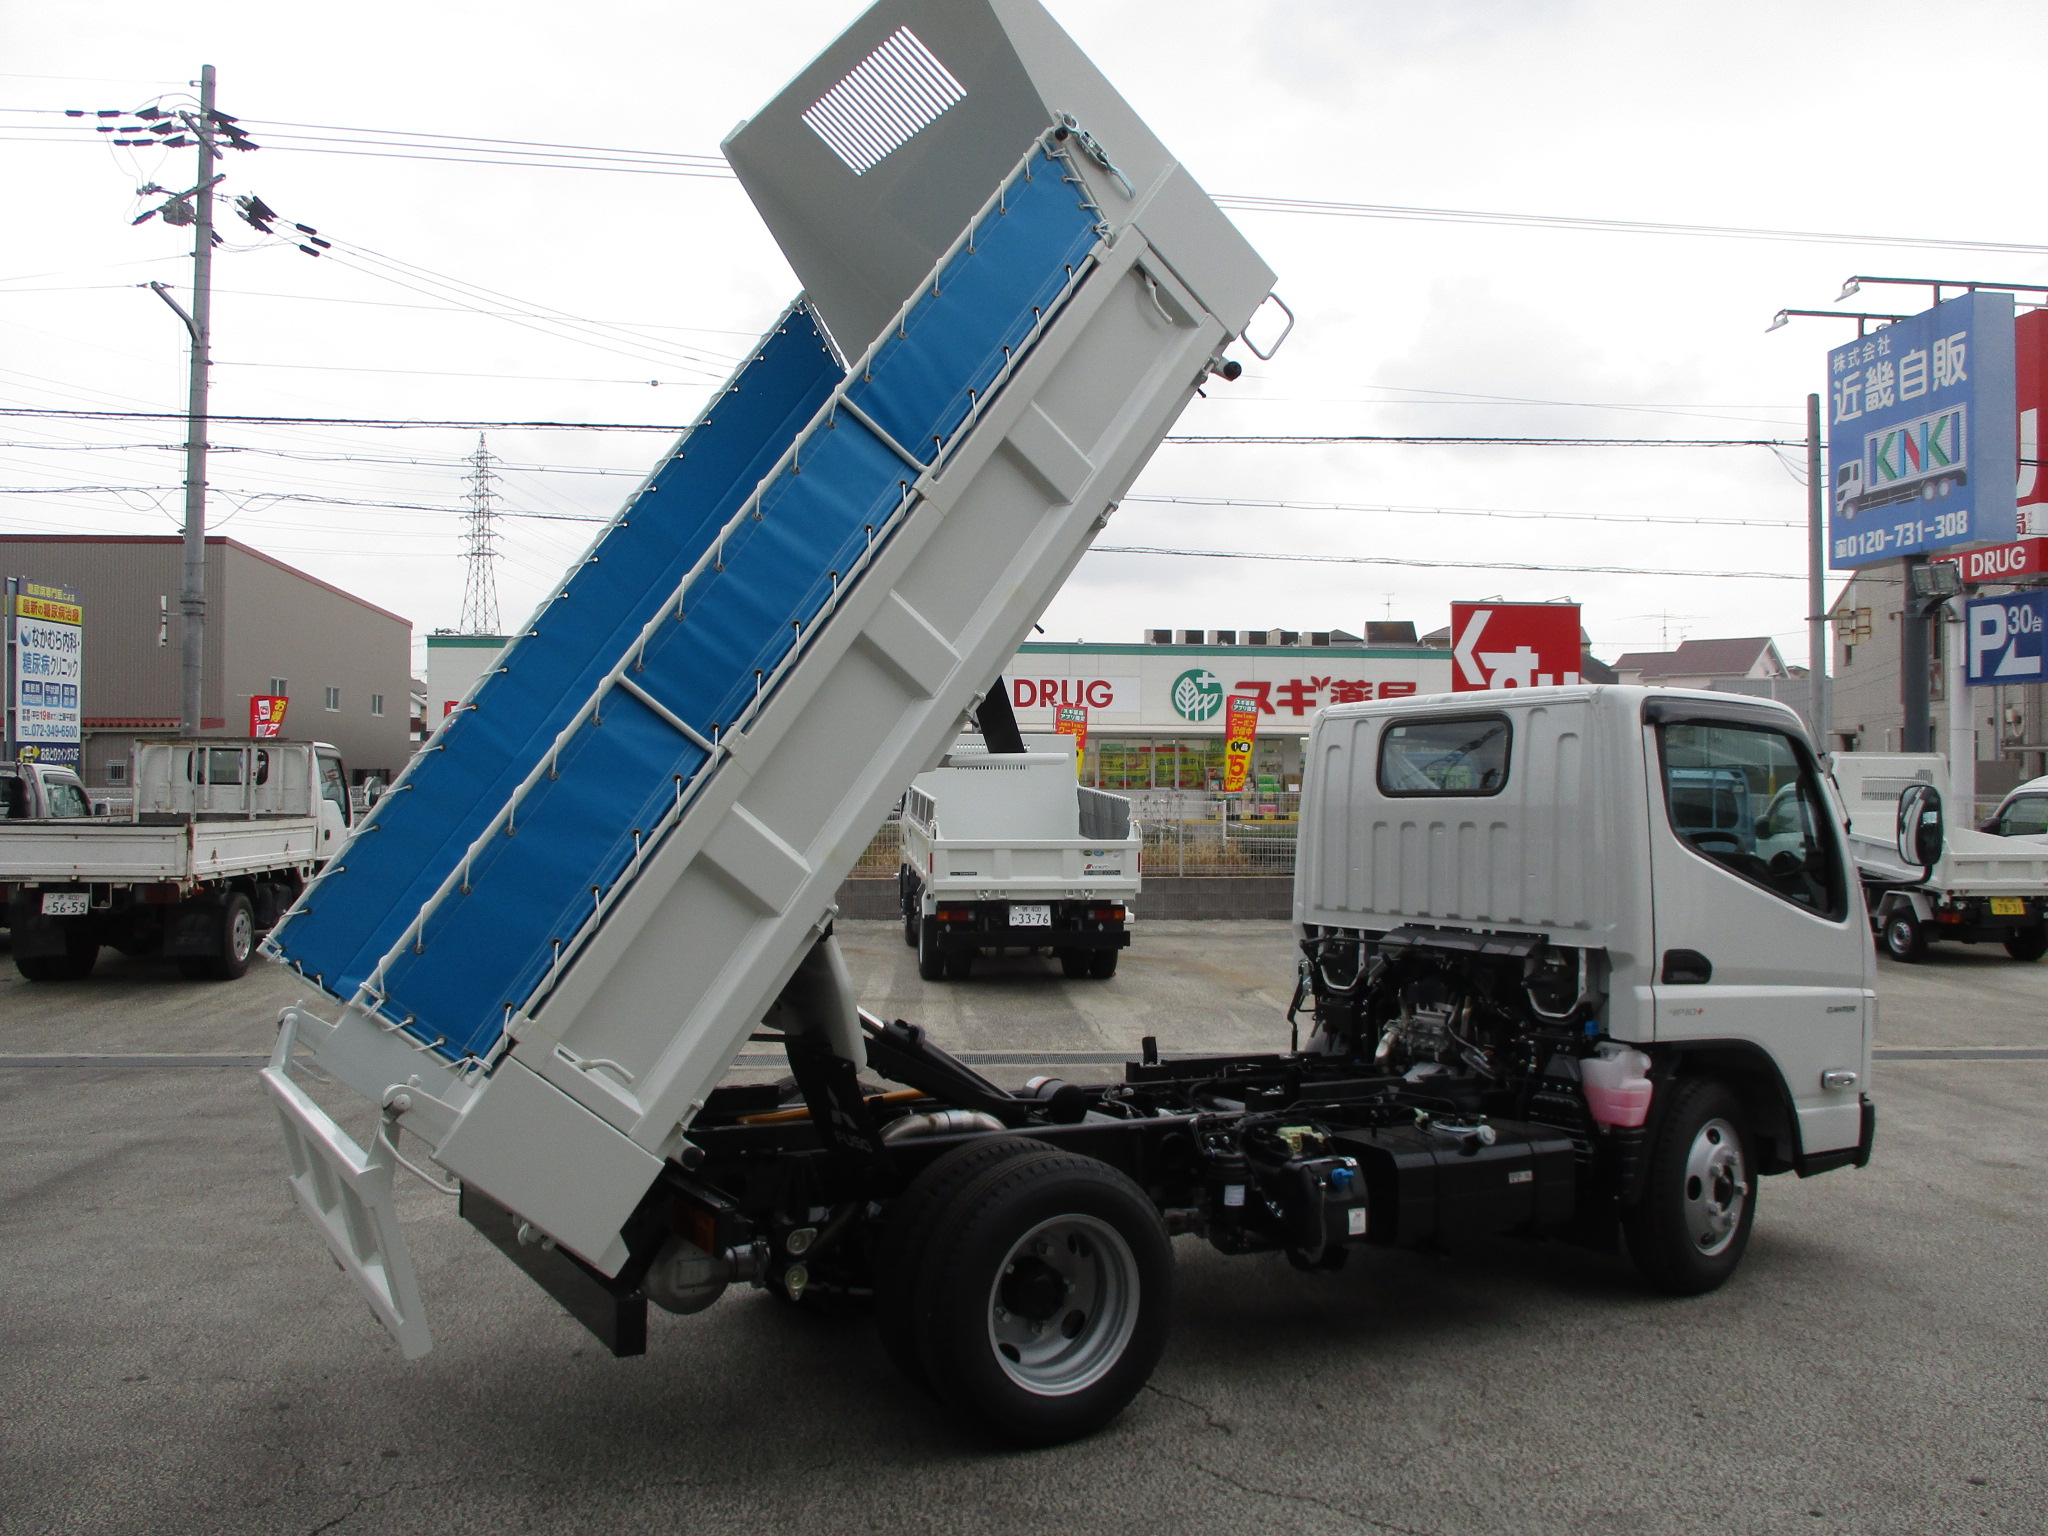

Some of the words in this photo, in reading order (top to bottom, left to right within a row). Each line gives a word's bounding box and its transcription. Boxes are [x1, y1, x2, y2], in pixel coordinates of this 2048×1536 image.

[1832, 334, 1891, 374] 株式会社
[1833, 331, 1968, 425] 近畿自販
[1847, 510, 1969, 558] 0120-731-308
[1971, 546, 2026, 577] DRUG
[1453, 610, 1579, 690] くす
[1013, 679, 1114, 708] DRUG
[52, 901, 86, 913] 56-59
[1018, 913, 1049, 925] 33-76
